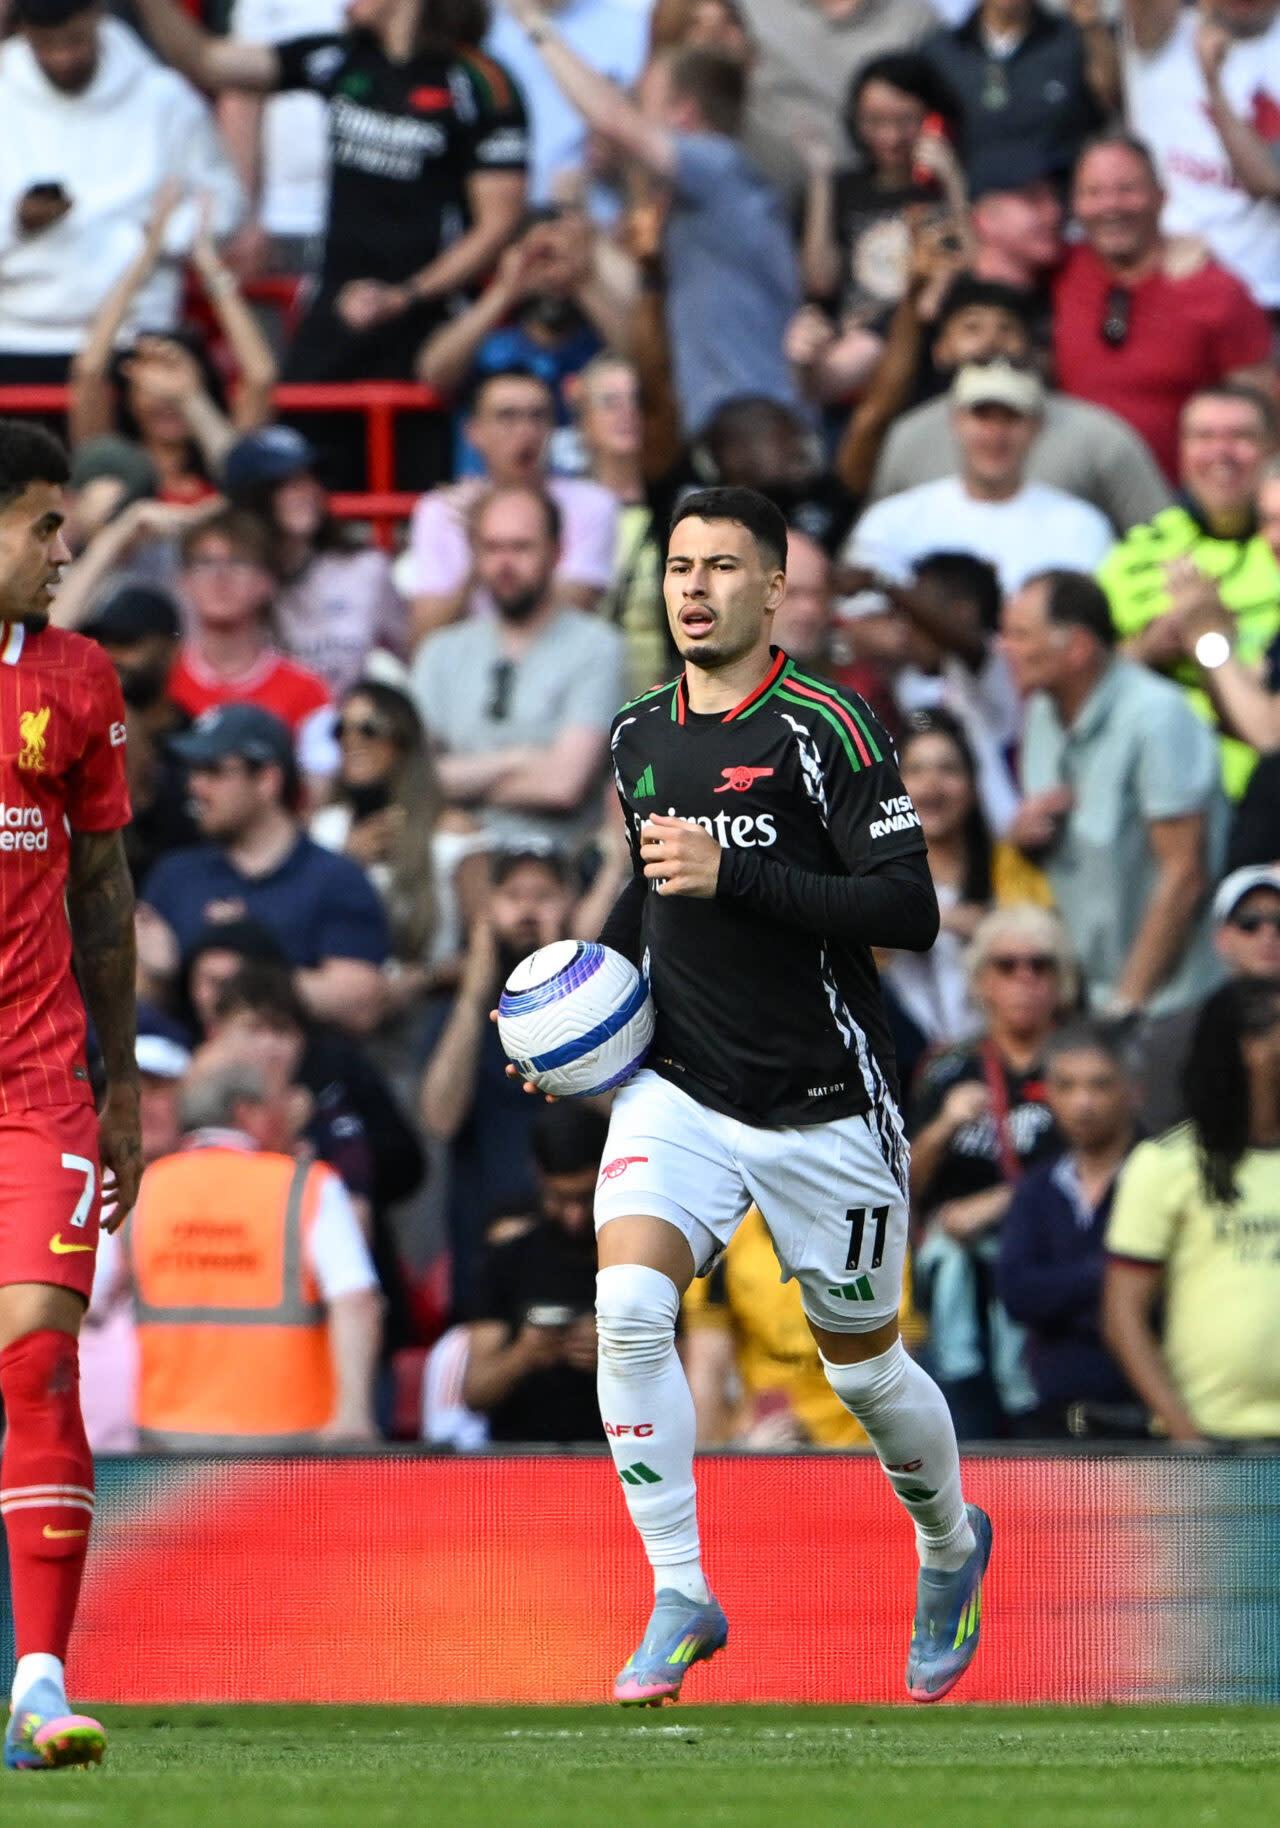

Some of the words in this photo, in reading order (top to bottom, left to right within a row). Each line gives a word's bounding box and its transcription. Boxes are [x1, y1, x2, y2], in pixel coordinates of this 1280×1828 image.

[61, 1152, 95, 1228] 7
[845, 1205, 890, 1271] 11
[604, 1421, 654, 1438] AFC
